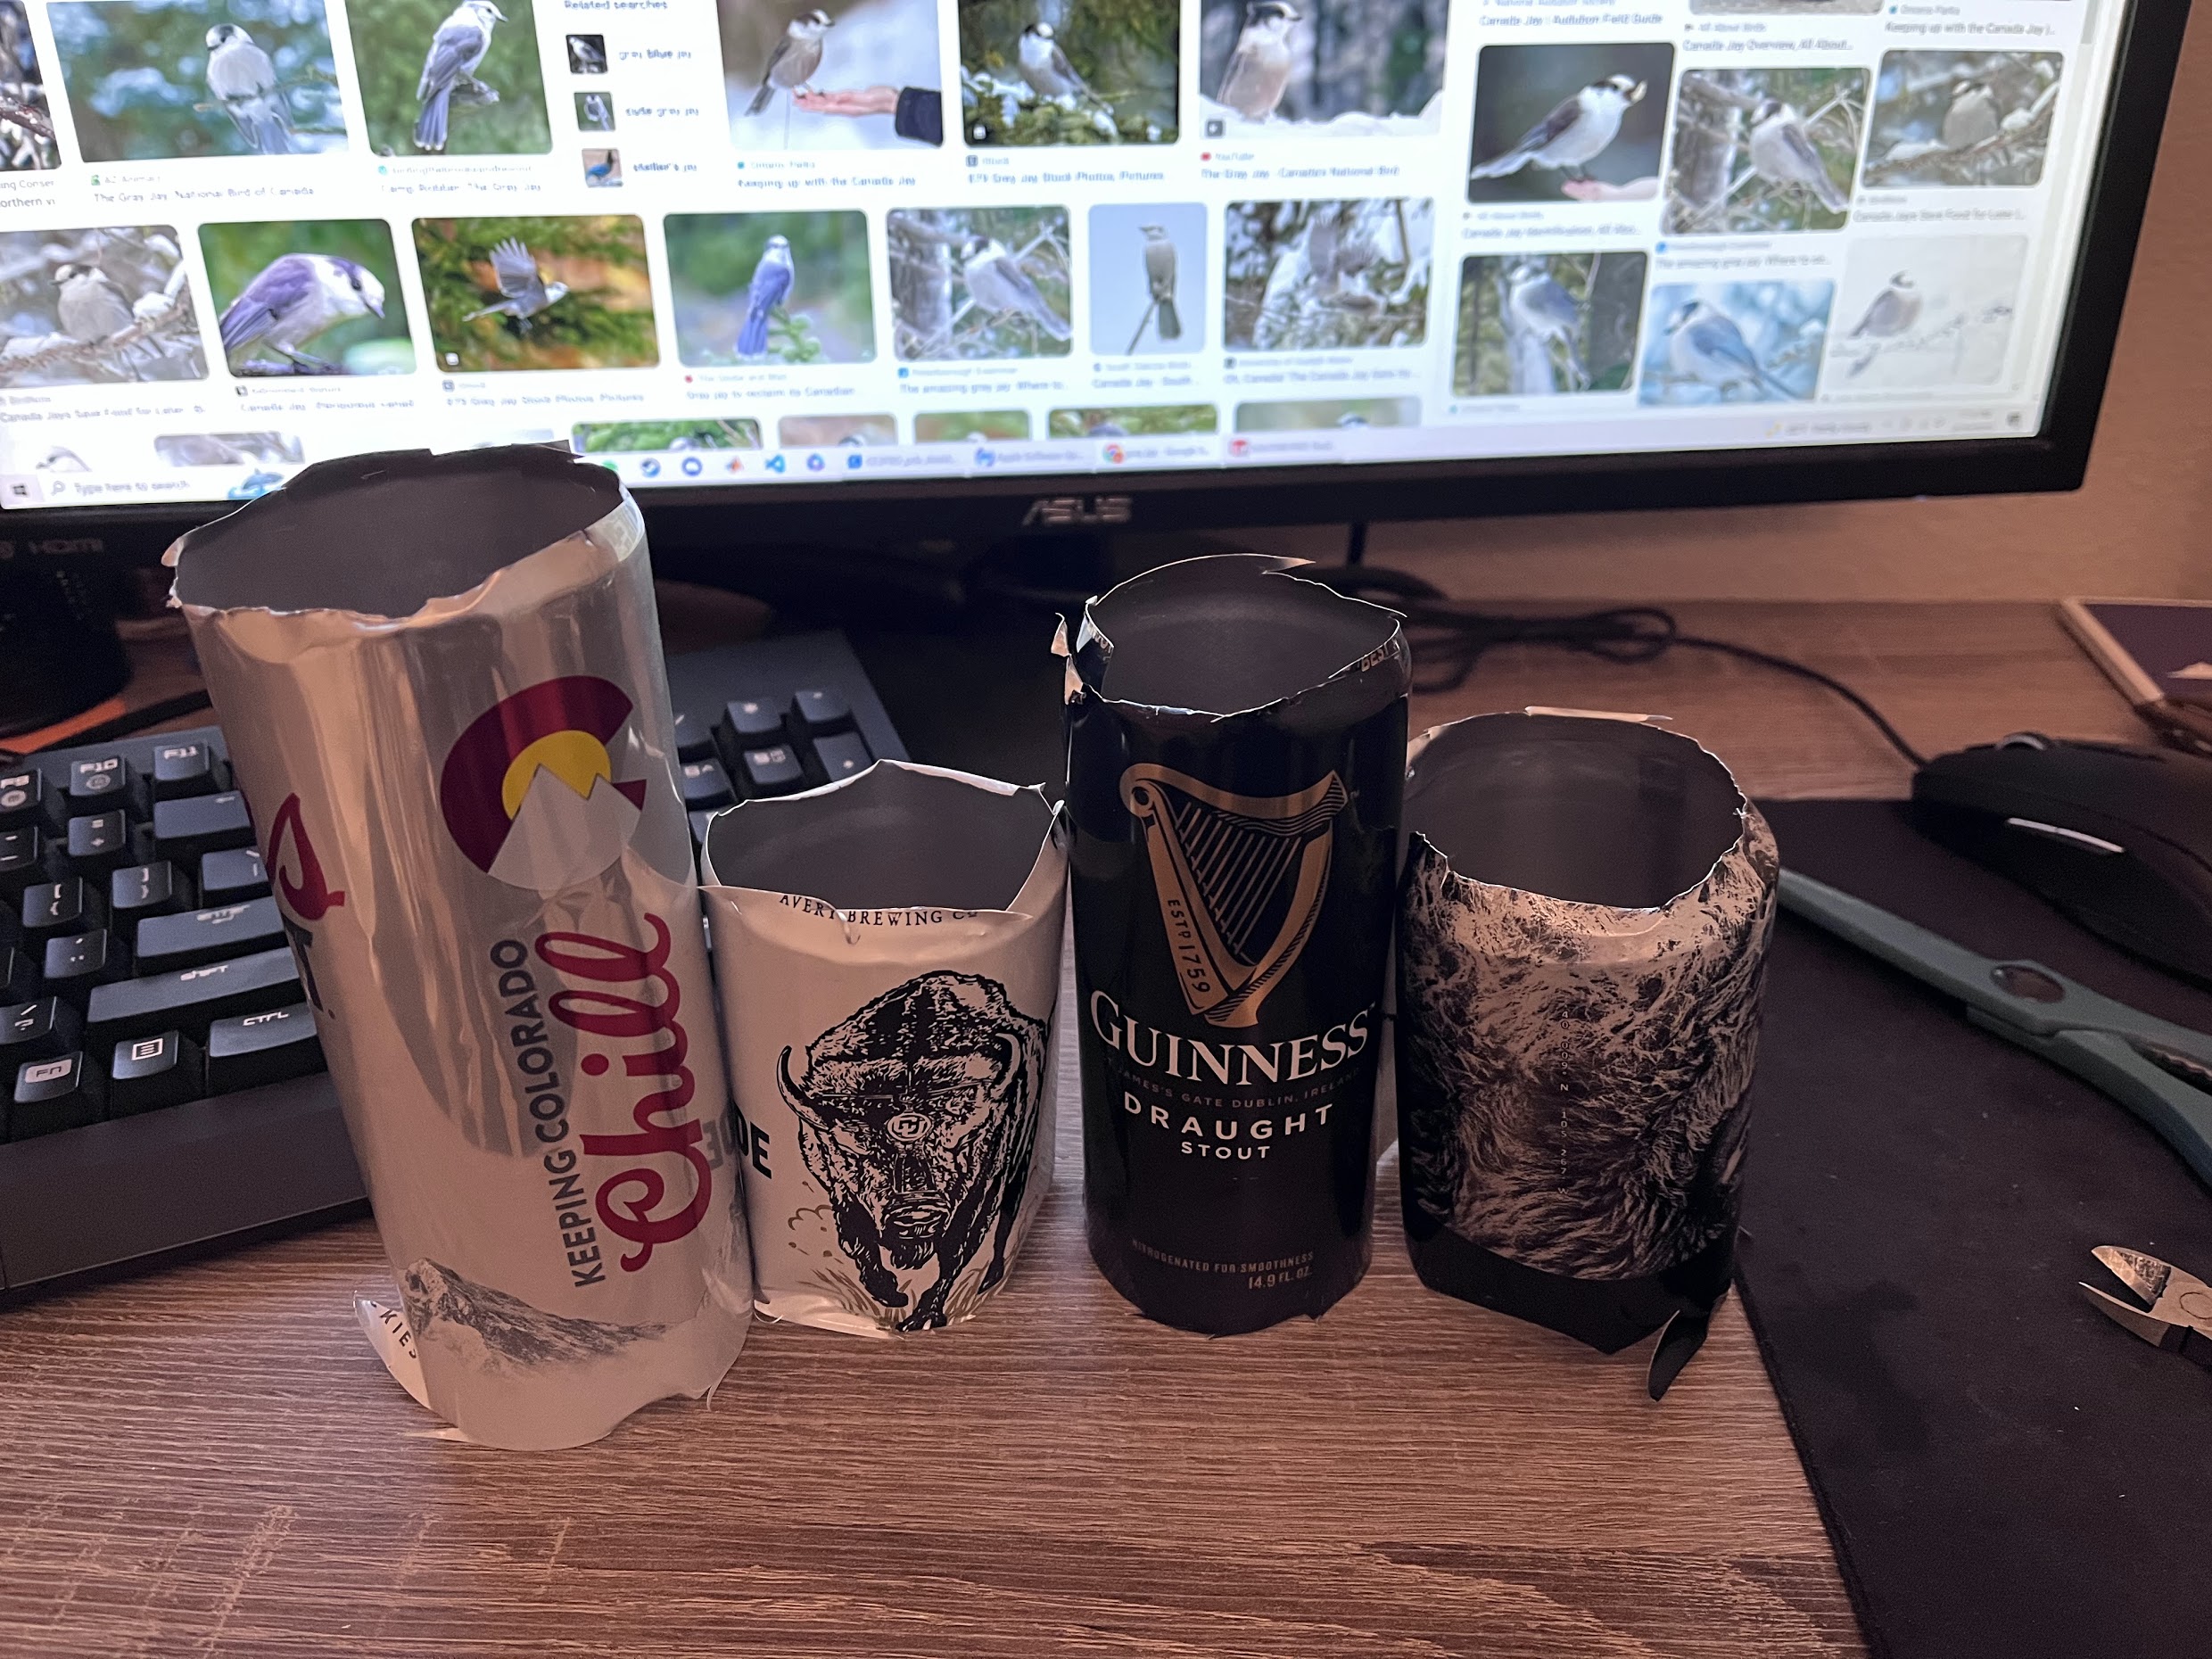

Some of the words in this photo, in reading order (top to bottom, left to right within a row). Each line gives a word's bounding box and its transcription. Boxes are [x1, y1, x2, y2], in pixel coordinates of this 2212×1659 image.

[1022, 497, 1133, 526] ASUS
[79, 757, 119, 774] F10
[846, 910, 944, 927] BREWING
[1177, 945, 1211, 993] 1759
[490, 938, 571, 1143] COLORADO
[1090, 989, 1372, 1086] GUINNESS
[534, 912, 713, 1273] Chill
[1181, 1092, 1224, 1108] GATE
[1124, 1090, 1333, 1141] DRAUGHT
[1180, 1141, 1271, 1160] STOUT
[543, 1148, 607, 1290] KEEPING
[1132, 1238, 1210, 1273] NITROGENATED
[1214, 1263, 1237, 1274] FOR
[1239, 1250, 1315, 1274] SMOOTHNESS
[1248, 1274, 1276, 1290] 14.9
